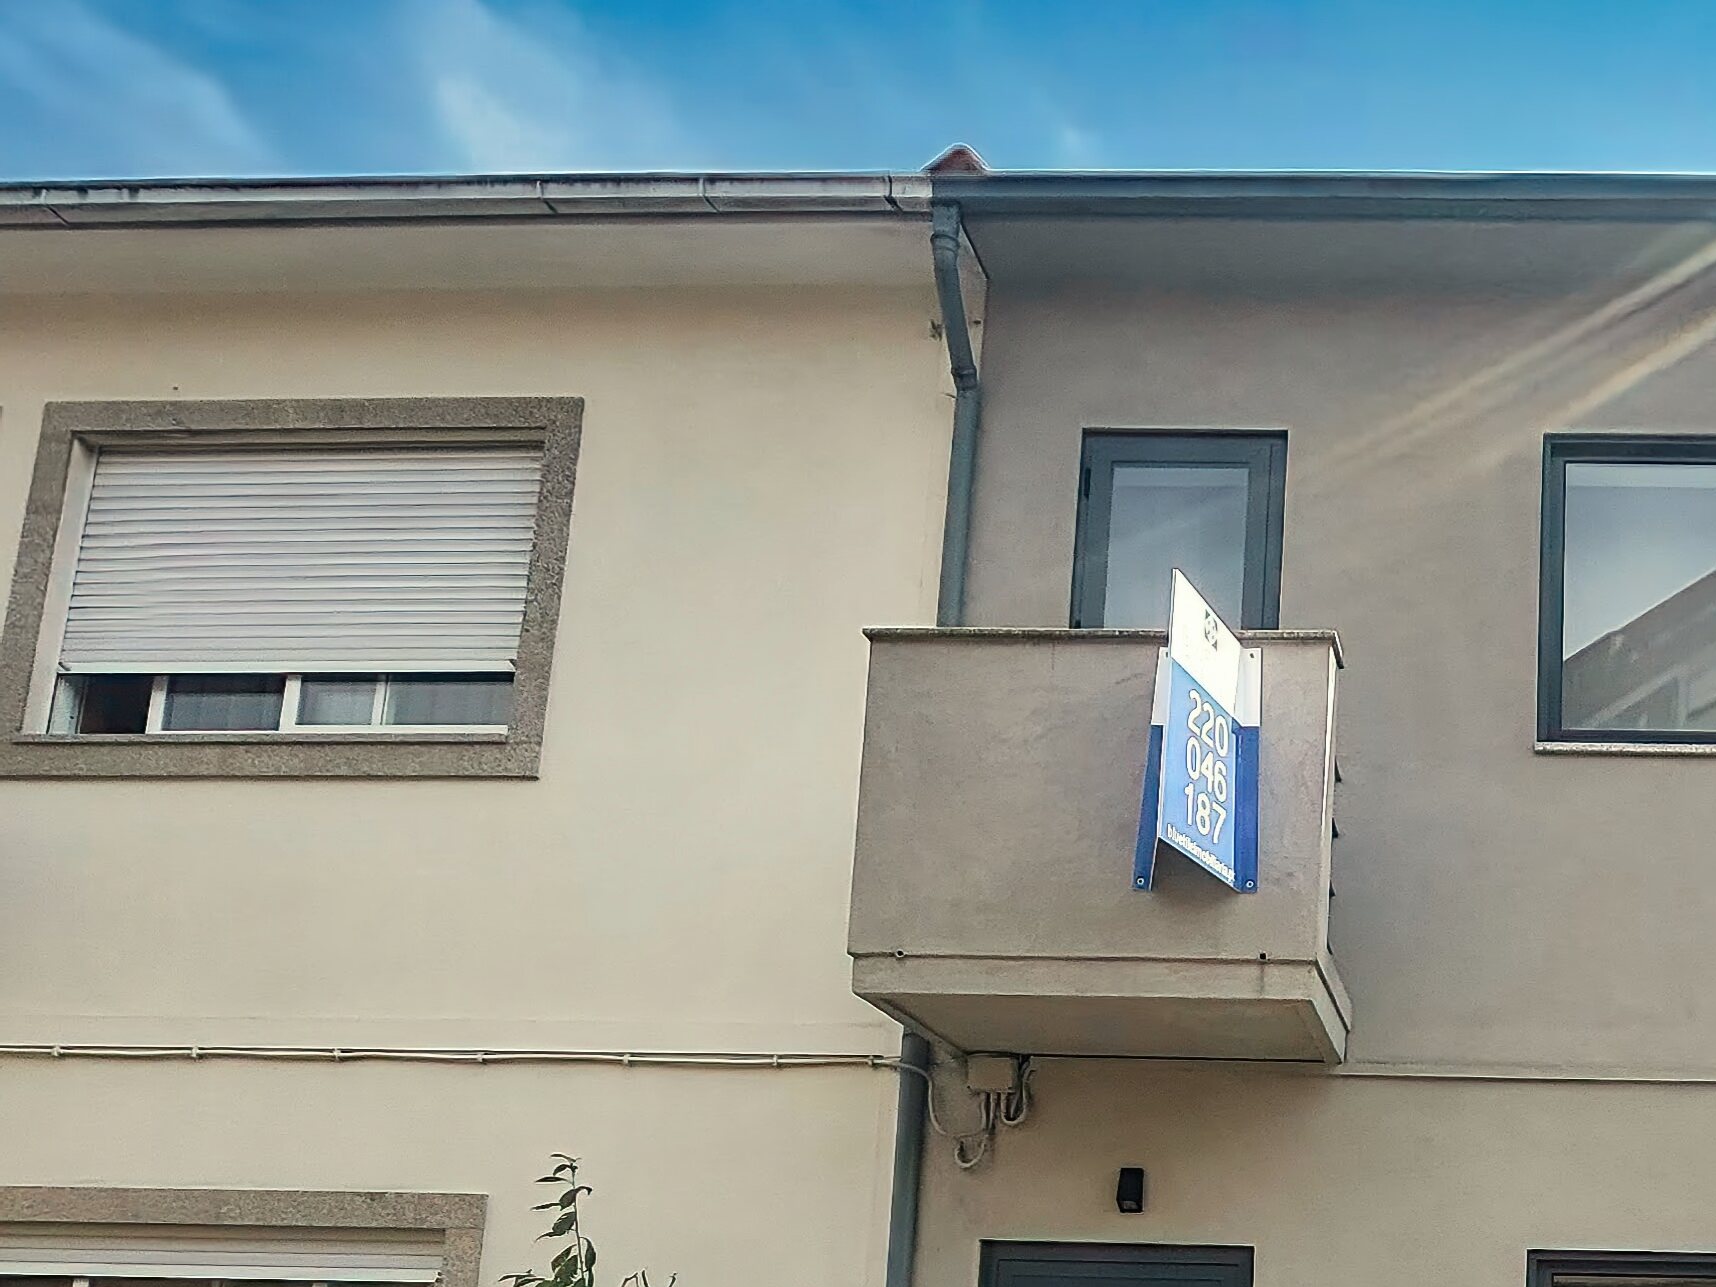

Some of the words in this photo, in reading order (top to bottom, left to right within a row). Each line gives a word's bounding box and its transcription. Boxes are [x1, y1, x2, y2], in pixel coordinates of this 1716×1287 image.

[1186, 688, 1230, 758] 220
[1185, 735, 1228, 804] 046
[1184, 782, 1228, 845] 187
